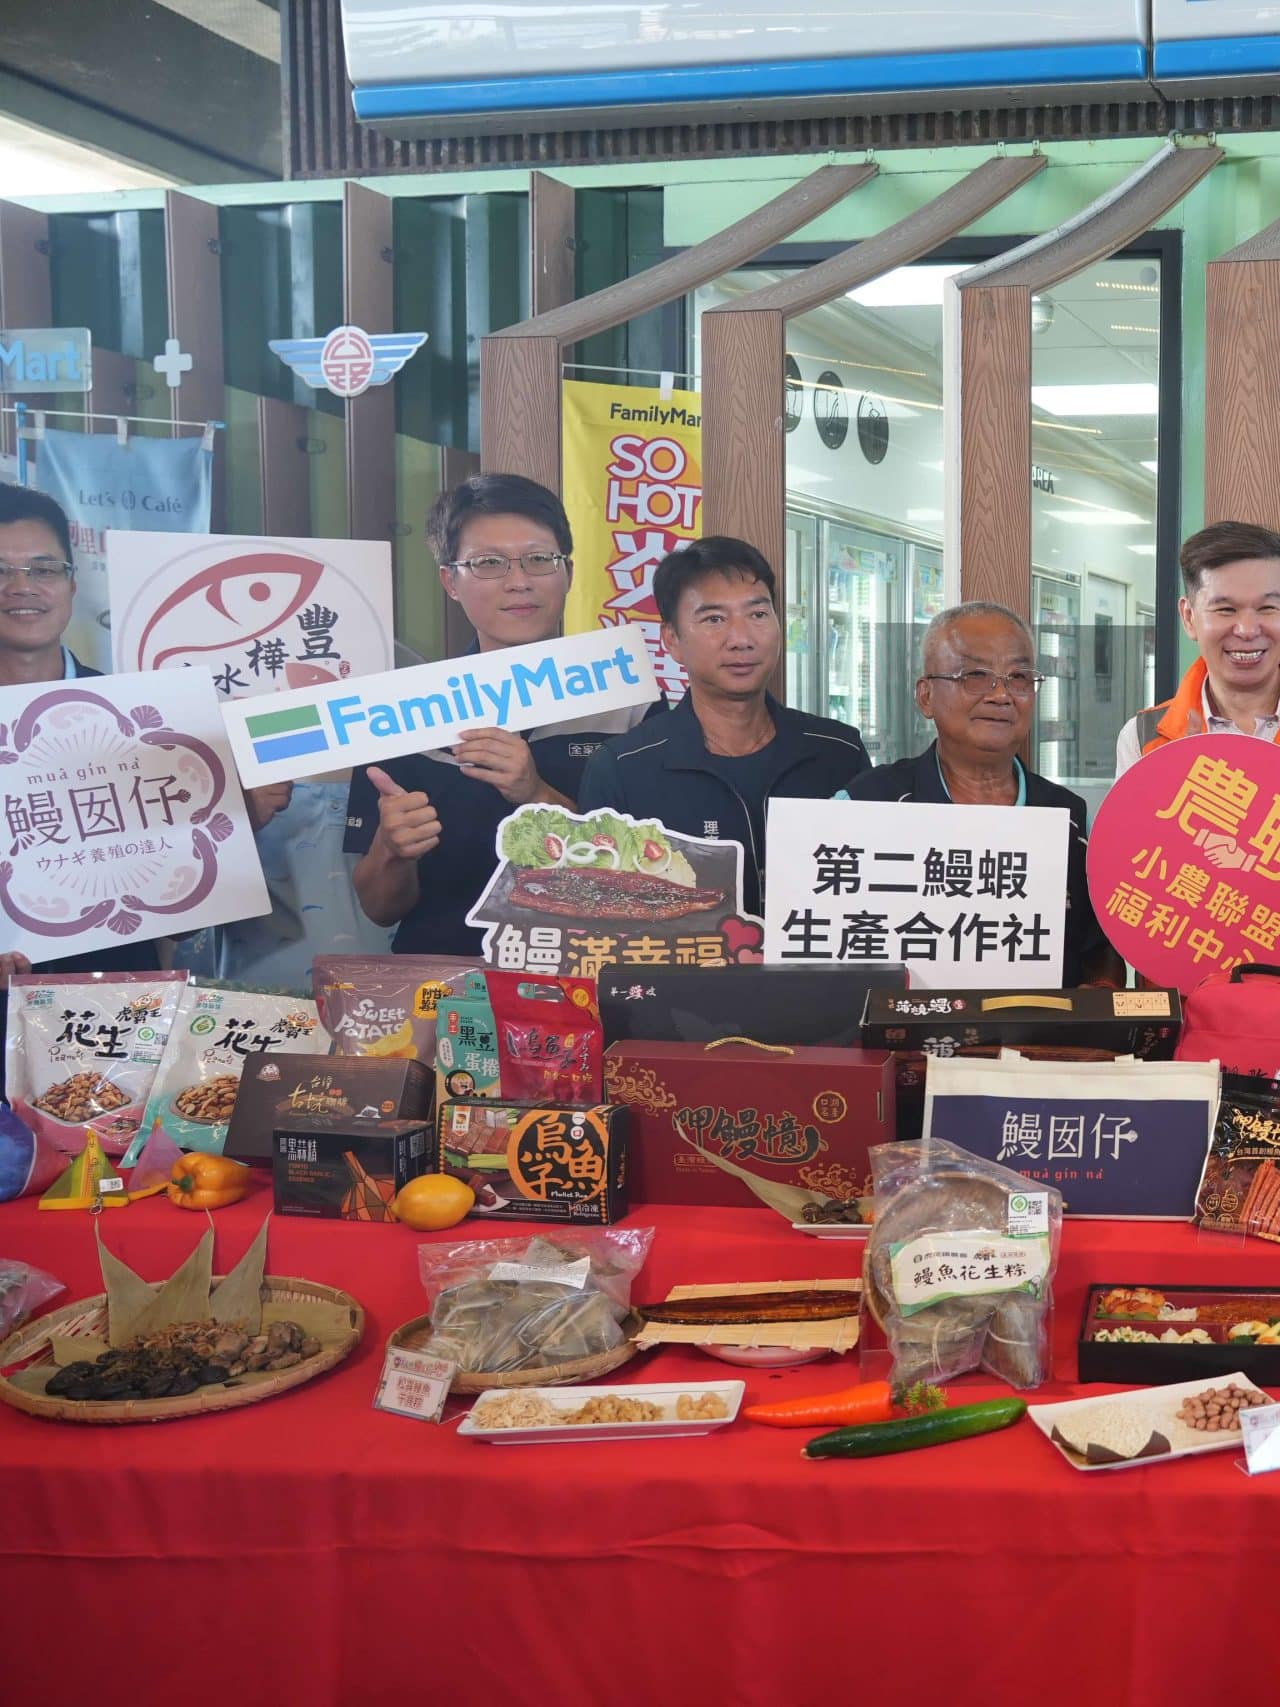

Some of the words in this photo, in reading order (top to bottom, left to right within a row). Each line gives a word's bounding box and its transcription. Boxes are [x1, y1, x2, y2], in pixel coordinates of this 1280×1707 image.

[606, 434, 687, 481] SO
[606, 478, 702, 530] HOT
[183, 603, 342, 695] 水樺豐
[327, 645, 640, 746] FamilyMart
[811, 843, 1029, 900] 第二鰻蝦
[780, 908, 1052, 964] 生產合作社
[56, 1009, 132, 1059] 花生
[913, 1263, 1027, 1289] 鰻魚花生粽
